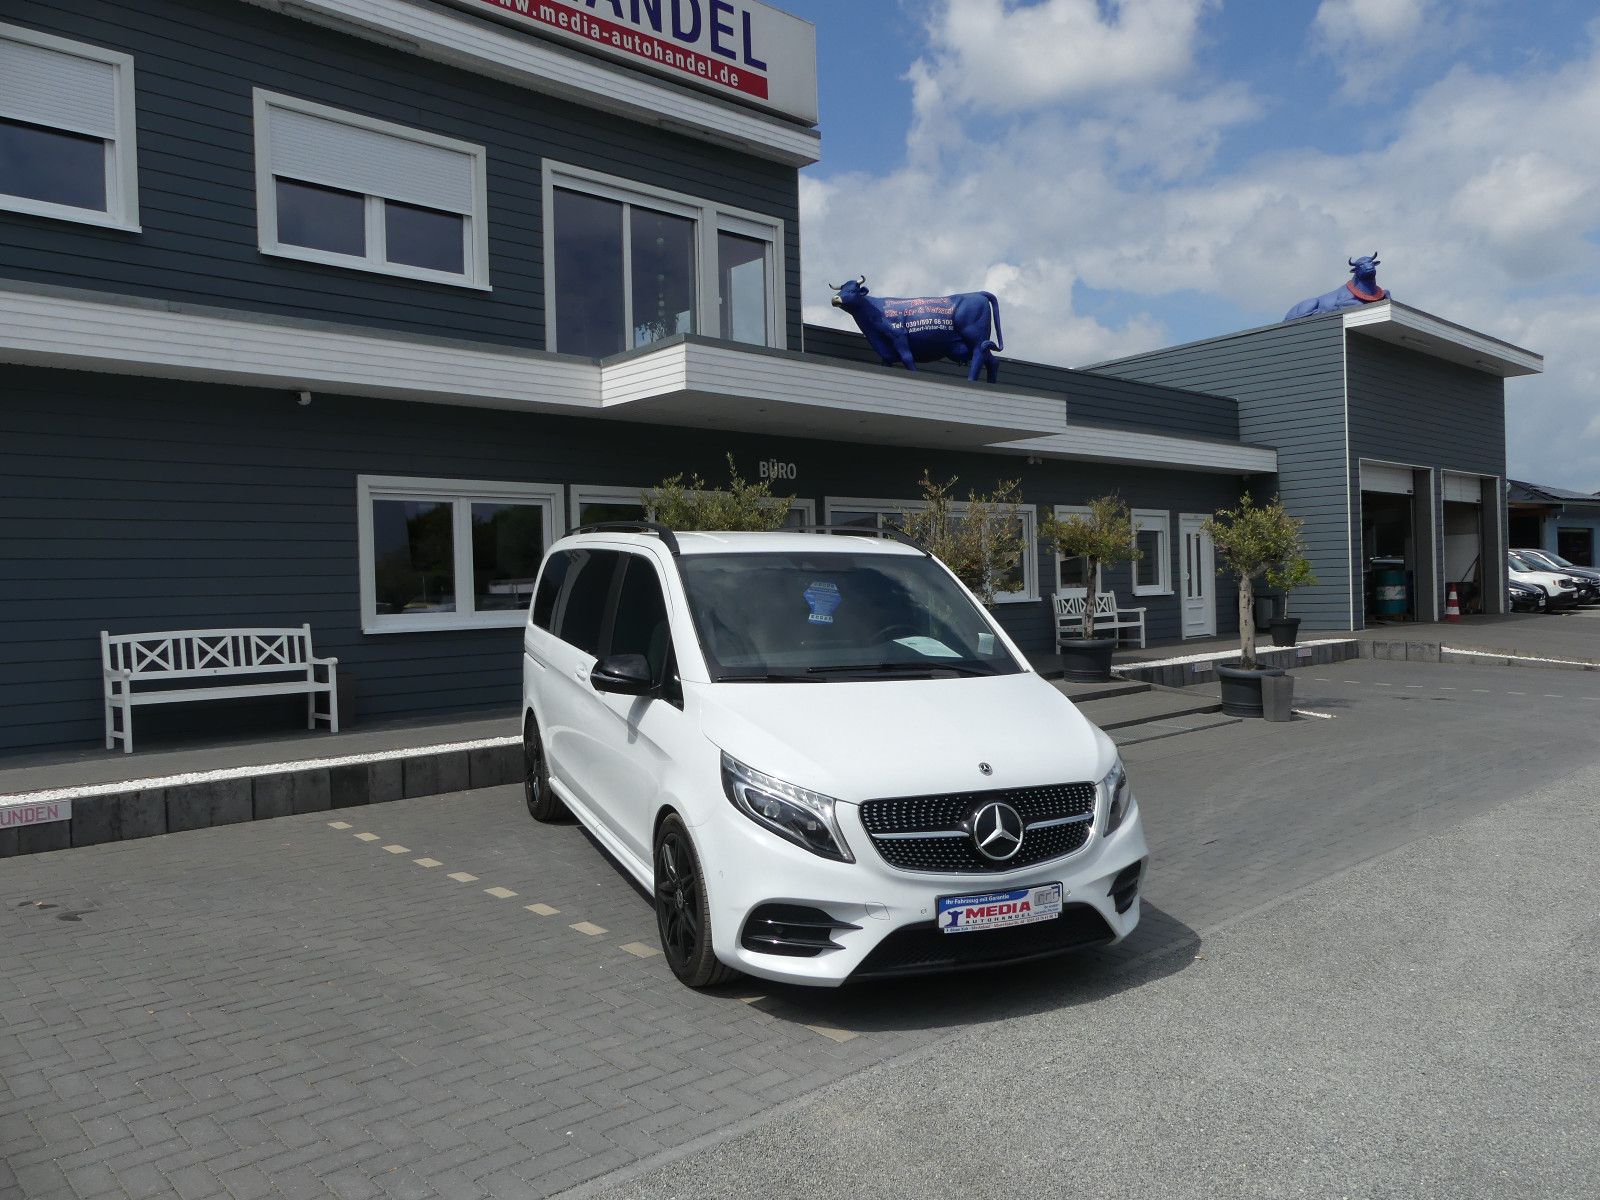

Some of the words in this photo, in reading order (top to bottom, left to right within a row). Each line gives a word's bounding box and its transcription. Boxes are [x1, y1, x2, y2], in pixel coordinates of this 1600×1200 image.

[488, 0, 739, 87] w.media-autohandel.de
[572, 0, 767, 72] NDEL
[760, 458, 797, 479] BÜRO
[965, 900, 1031, 919] MEDIA
[965, 912, 1031, 924] AUTOHANDEL
